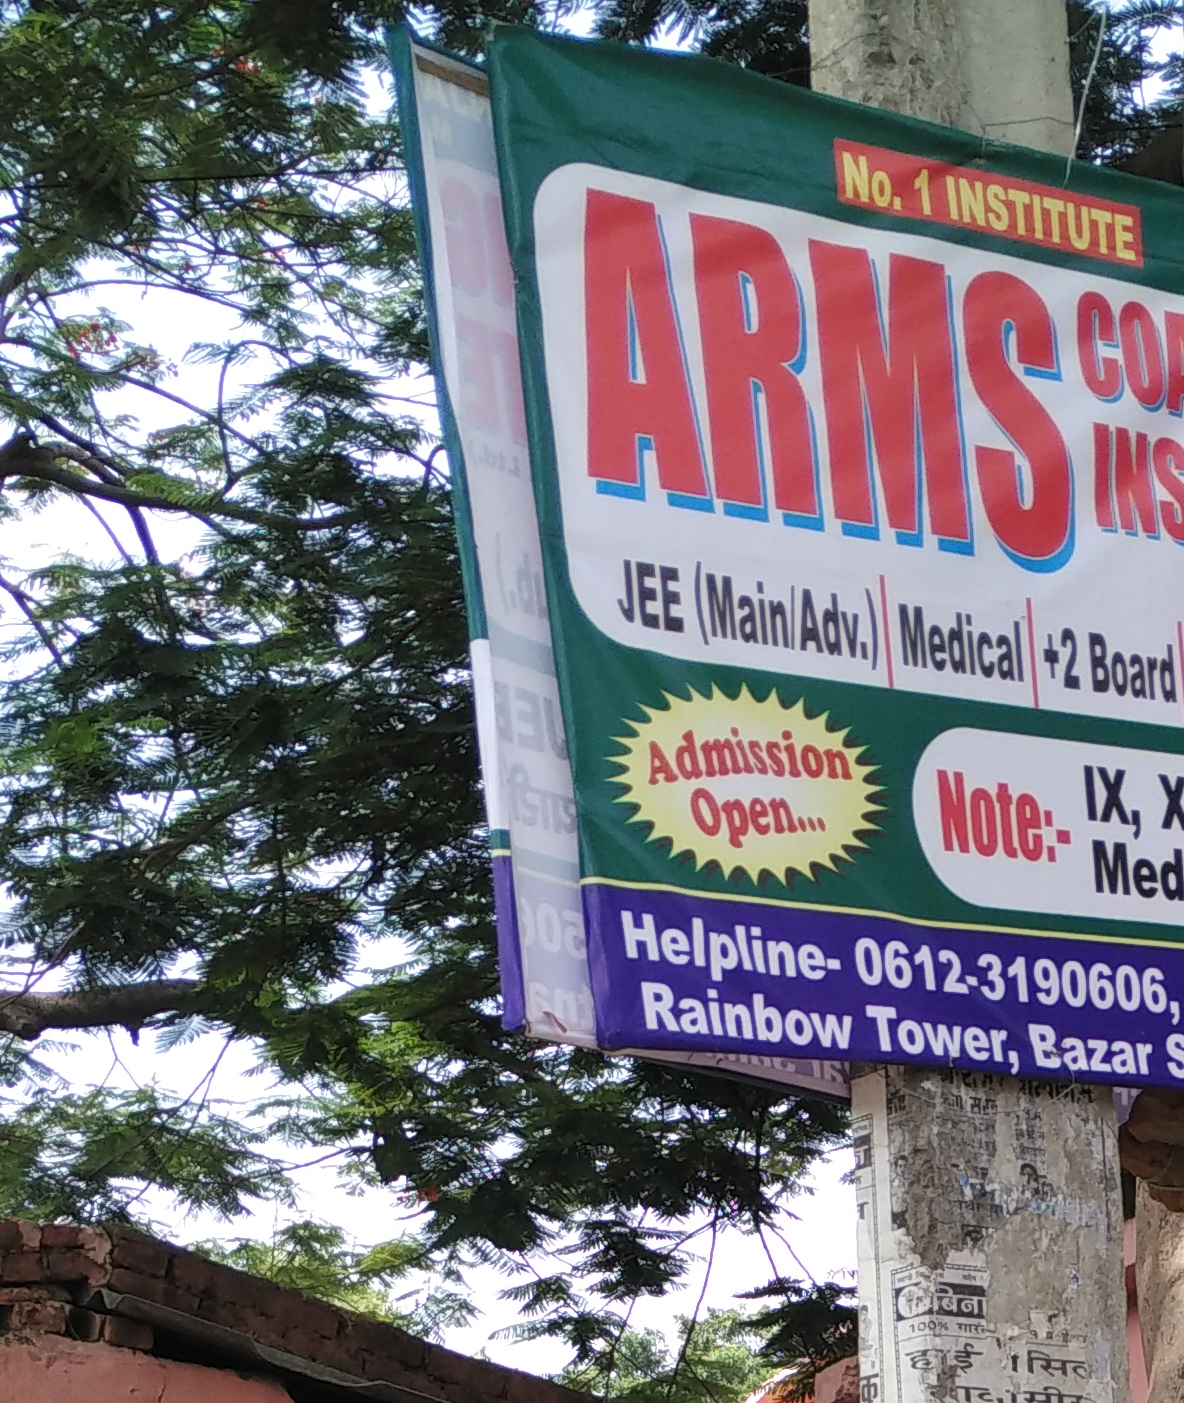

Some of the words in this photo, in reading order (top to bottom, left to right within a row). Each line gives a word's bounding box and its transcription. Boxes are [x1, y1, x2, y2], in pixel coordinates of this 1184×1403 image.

[842, 151, 902, 210] No.
[914, 169, 933, 215] 1
[945, 175, 1137, 261] INSTITUTE
[584, 188, 1076, 574] ARMS
[616, 558, 685, 633] JEE
[898, 606, 1025, 685] Medical
[1043, 629, 1081, 690] +2
[1087, 633, 1178, 704] Board
[647, 726, 854, 786] Admission
[1083, 764, 1140, 840] IX,
[690, 787, 827, 850] Open...
[936, 769, 1071, 863] Note:-
[620, 909, 841, 981] Helpline-
[855, 936, 1181, 1026] 0612-3190606,
[640, 981, 853, 1051] Rainbow
[865, 1004, 1021, 1075] Tower,
[1028, 1022, 1152, 1079] Bazar
